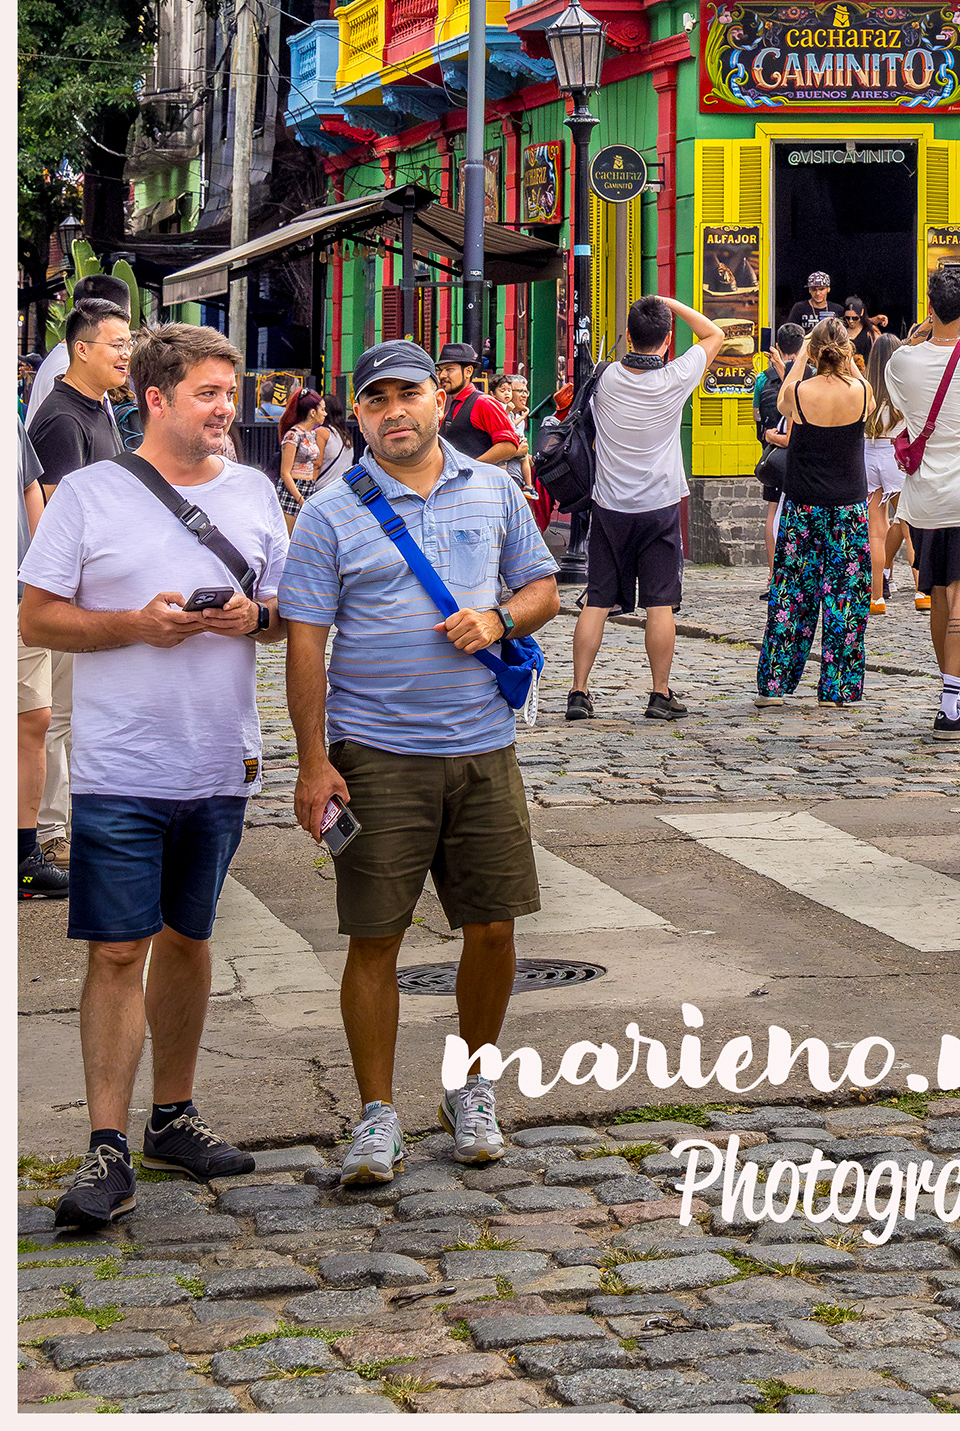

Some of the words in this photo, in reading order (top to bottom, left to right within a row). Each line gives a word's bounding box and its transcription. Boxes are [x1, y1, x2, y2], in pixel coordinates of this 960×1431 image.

[752, 48, 936, 90] CAMINITO
[796, 90, 847, 99] BUENOS
[851, 90, 889, 99] AIRES
[788, 149, 905, 166] @VISITCAMINITO
[706, 234, 757, 245] ALFAJOR
